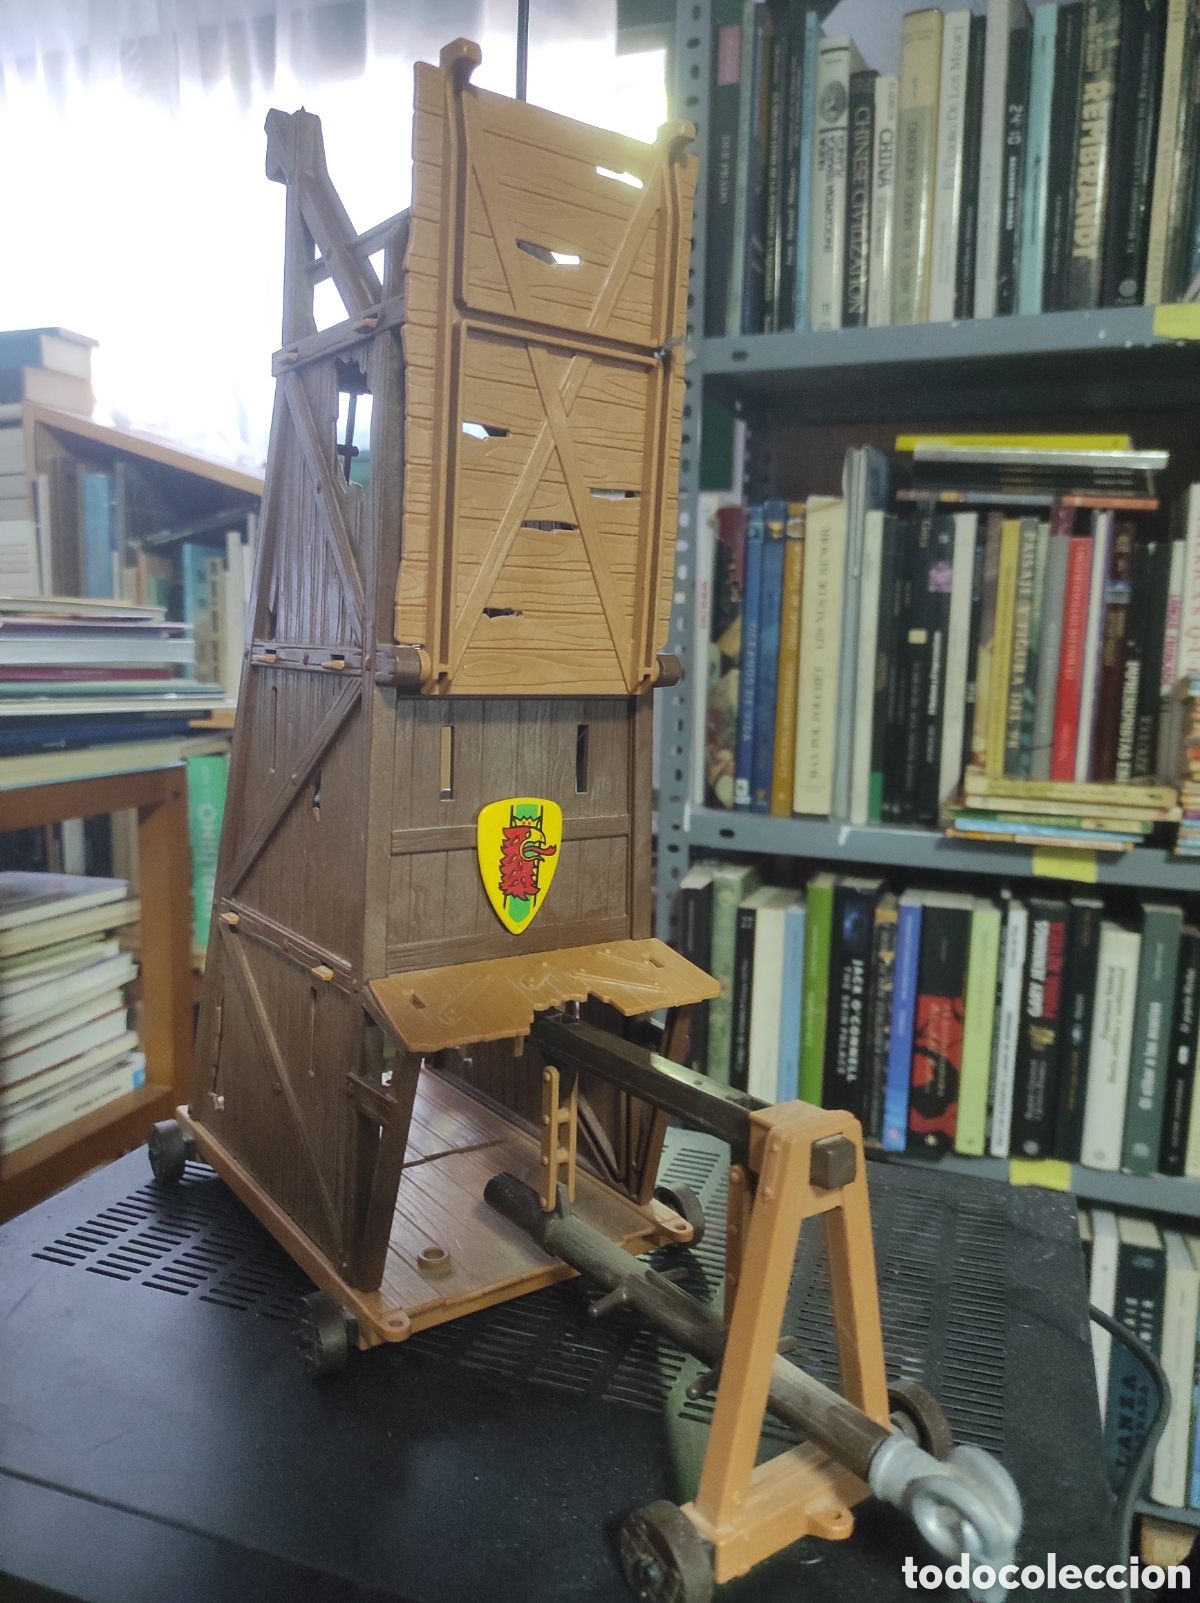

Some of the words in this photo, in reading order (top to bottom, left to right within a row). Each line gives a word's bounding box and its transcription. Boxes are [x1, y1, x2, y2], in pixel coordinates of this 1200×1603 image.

[851, 106, 871, 184] CHINESE
[877, 128, 895, 190] CHINA
[905, 122, 918, 181] MODERNO
[1071, 79, 1112, 261] REMBRANDT
[903, 187, 914, 231] MUNDO
[848, 188, 868, 314] CIVILIZATION
[1019, 530, 1037, 595] PAISAJE
[1011, 623, 1031, 685] FIGURA
[742, 712, 754, 741] VIDA
[744, 690, 755, 706] DE
[1116, 660, 1141, 760] IMPRESIONISTAS
[851, 959, 865, 995] JACK
[1030, 920, 1050, 981] JENNINGS
[1026, 981, 1044, 1018] GARY
[846, 998, 863, 1083] O'CONNELL
[1115, 1374, 1137, 1470] LANZA
